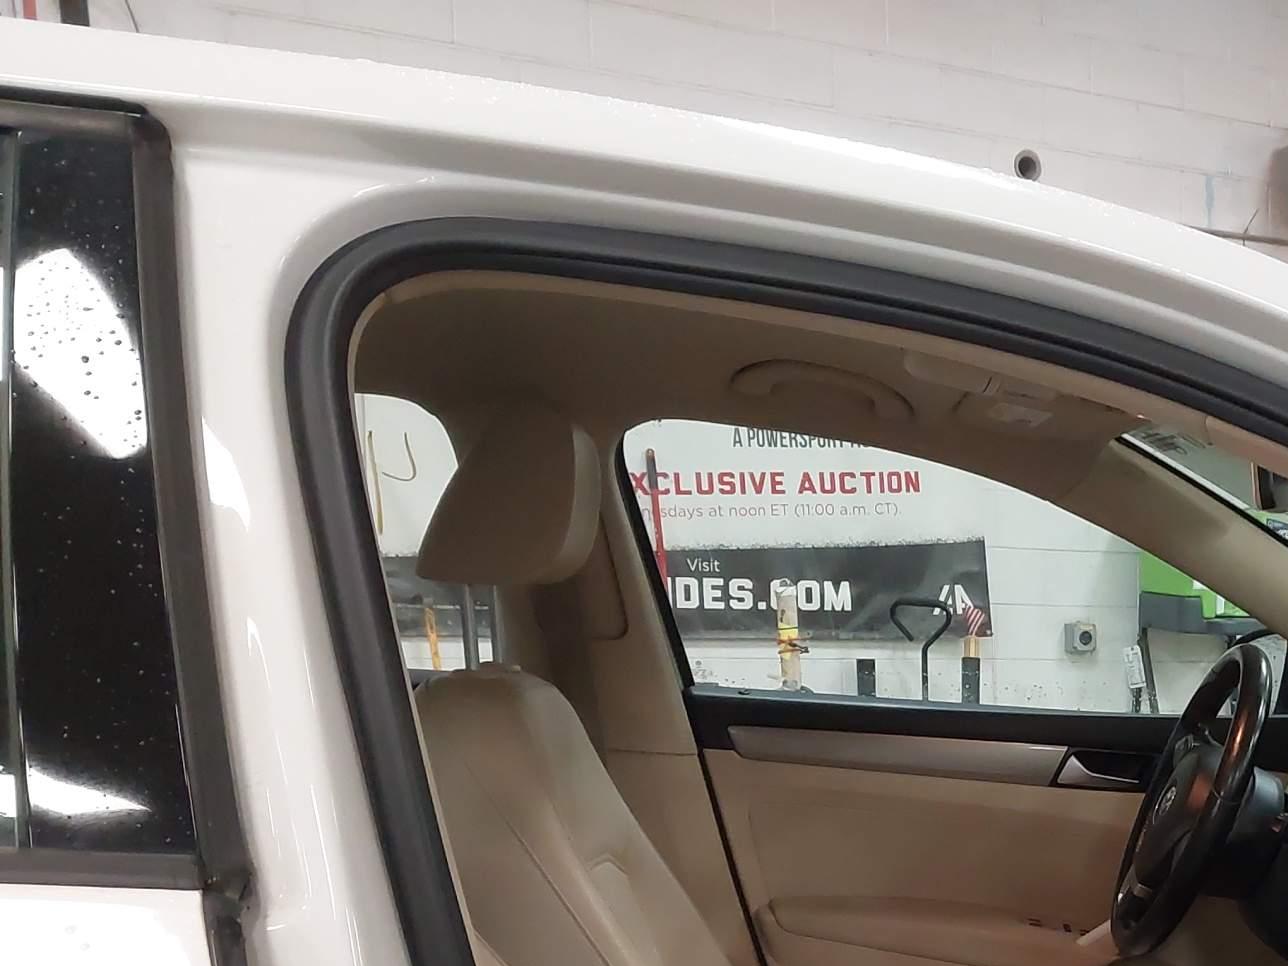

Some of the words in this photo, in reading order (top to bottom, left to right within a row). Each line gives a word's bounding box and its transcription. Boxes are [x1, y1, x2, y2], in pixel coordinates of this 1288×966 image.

[733, 427, 743, 448] A
[798, 471, 921, 495] AUCTION
[641, 504, 704, 520] nsdays
[708, 503, 725, 518] at
[728, 506, 767, 519] noon
[770, 502, 789, 517] ET
[793, 501, 836, 519] (11:00
[838, 506, 871, 517] a.m.
[873, 501, 902, 517] CT).
[686, 557, 721, 573] Visit
